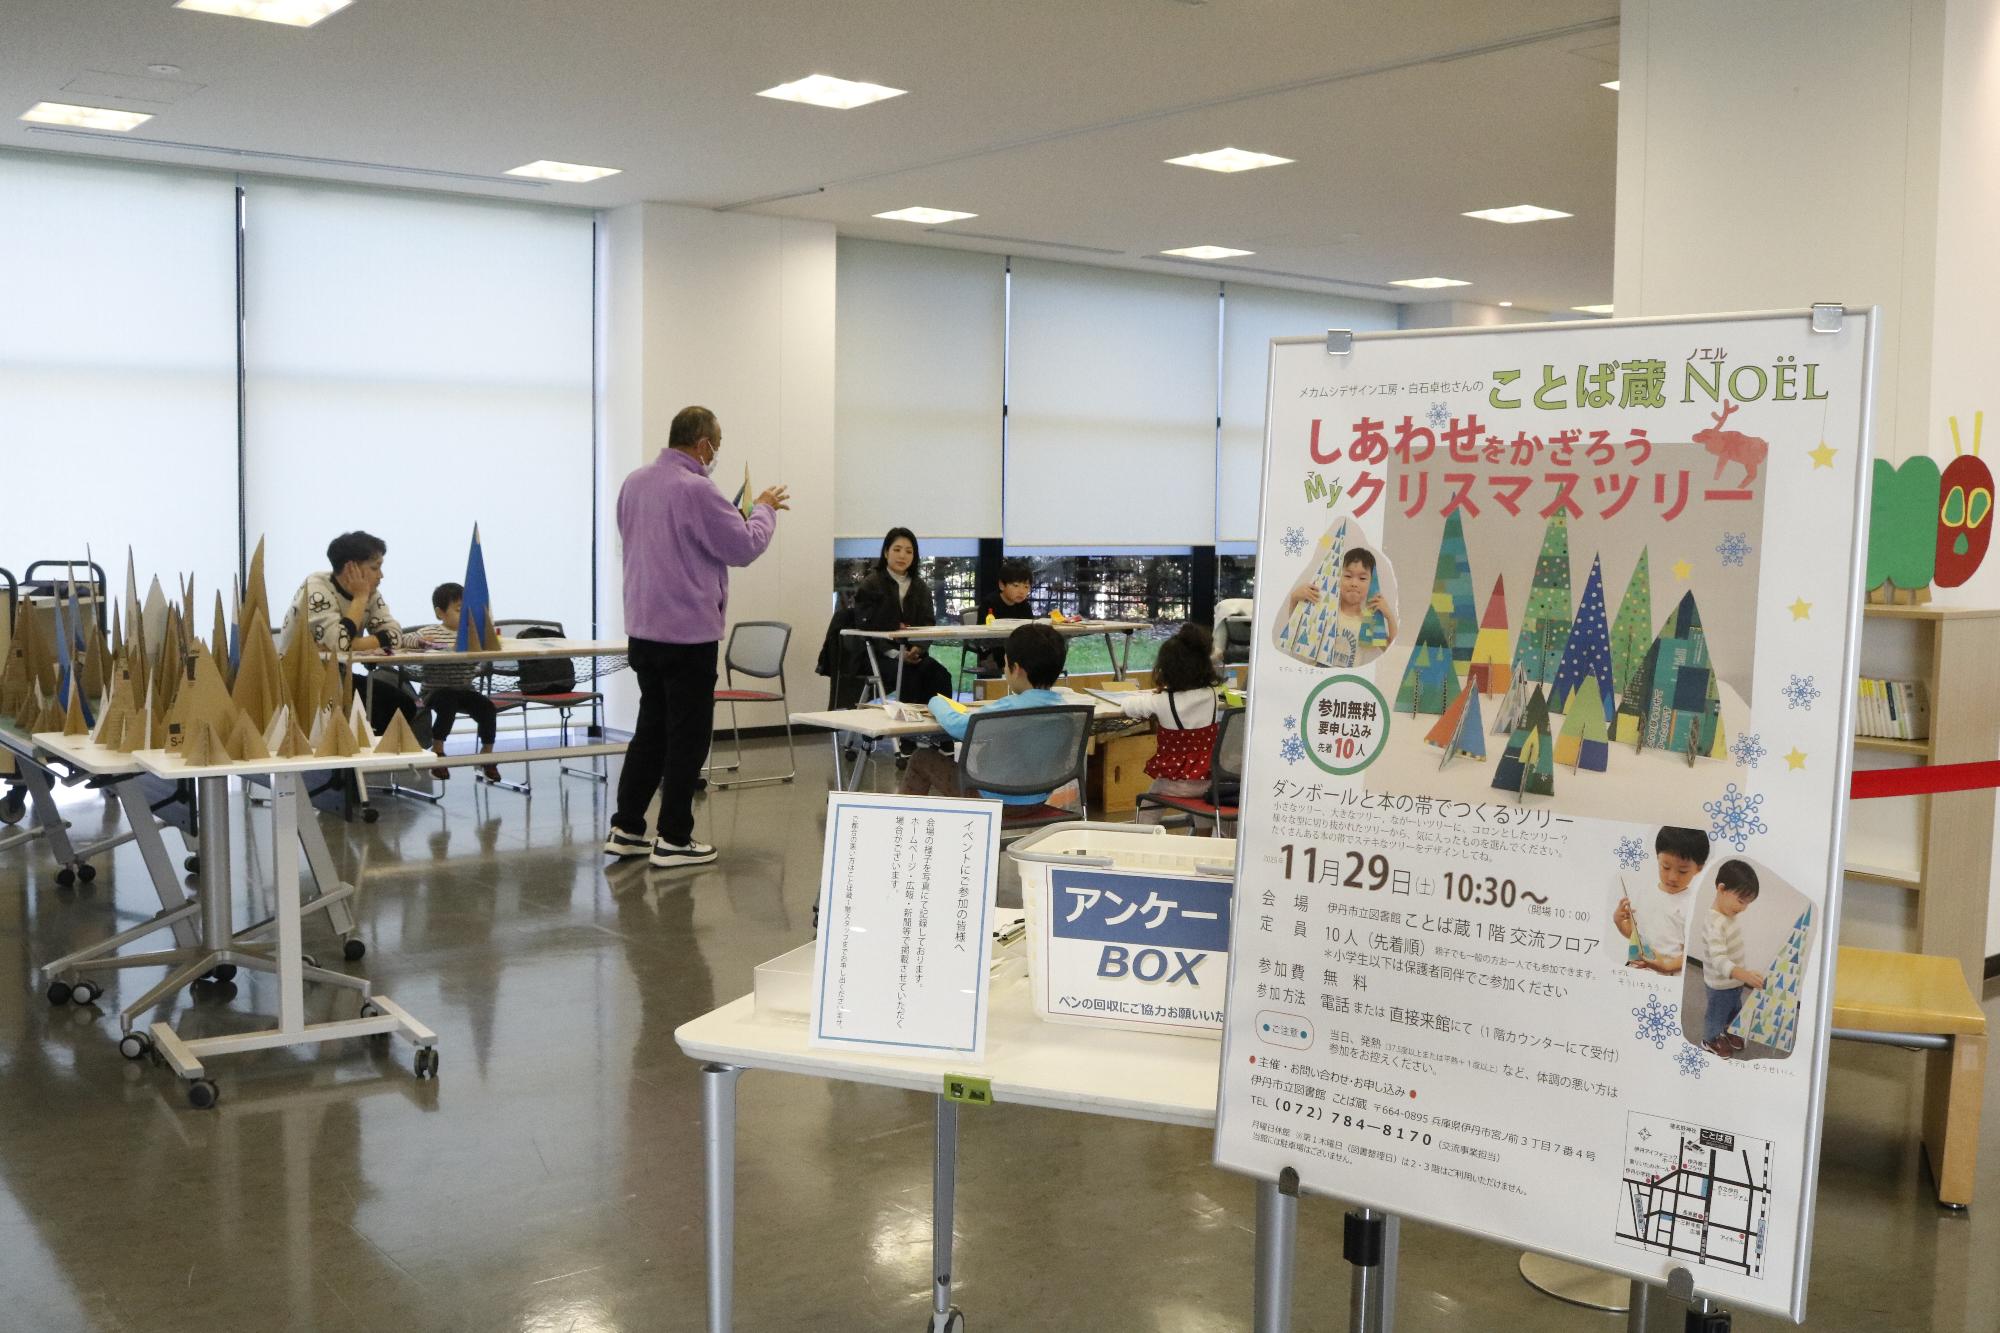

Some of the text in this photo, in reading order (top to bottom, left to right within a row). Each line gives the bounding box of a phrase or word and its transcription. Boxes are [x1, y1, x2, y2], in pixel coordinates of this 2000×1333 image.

[1687, 347, 1728, 360] ノエル
[1299, 355, 1829, 410] メカムシデザイン工房・白石卓也さんの ことば蔵 NOËL
[1309, 414, 1653, 466] しあわせをかざろう
[1304, 470, 1754, 521] My クリスマスツリー
[1317, 720, 1372, 738] 要申し込み
[1318, 698, 1377, 721] 参加無料
[1272, 779, 1575, 829] ダンボールと本の帯でつくるツリー
[1065, 886, 1233, 930] アンケー
[1326, 902, 1402, 925] 伊丹市立図書館
[1509, 926, 1600, 955] 交流フロア
[1096, 945, 1208, 986] BOX
[1257, 957, 1306, 982] 参加費
[1256, 982, 1307, 1006] 参加方法
[1272, 1024, 1299, 1038] ご注意
[1503, 1063, 1620, 1099] など、体調の悪い方は
[1328, 1042, 1439, 1077] 参加をお控えください。
[1250, 1074, 1327, 1102] 伊丹市立図書館
[1331, 1091, 1368, 1113] ことば蔵
[1251, 1095, 1270, 1108] TEL
